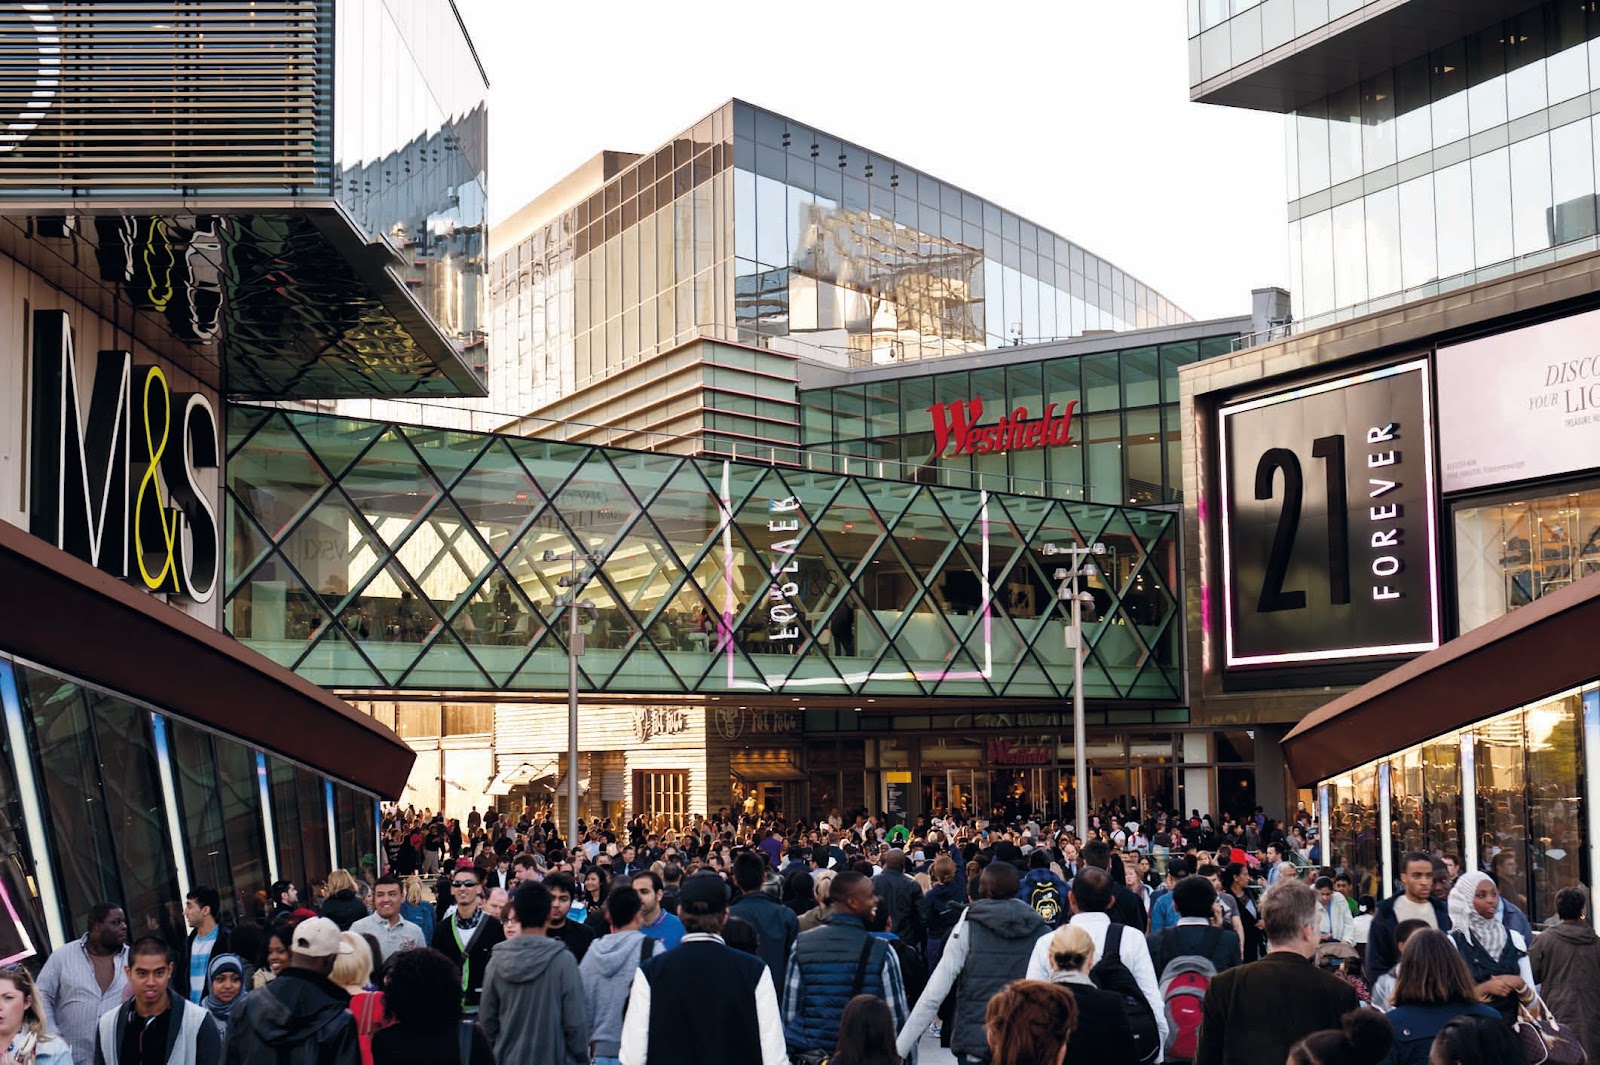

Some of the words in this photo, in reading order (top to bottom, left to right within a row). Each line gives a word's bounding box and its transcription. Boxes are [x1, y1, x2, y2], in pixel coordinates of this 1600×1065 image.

[36, 309, 220, 604] M&S
[925, 397, 1079, 458] Westfield
[1528, 392, 1558, 411] YOUR
[1254, 434, 1351, 613] 21
[1367, 423, 1402, 600] FOREVER
